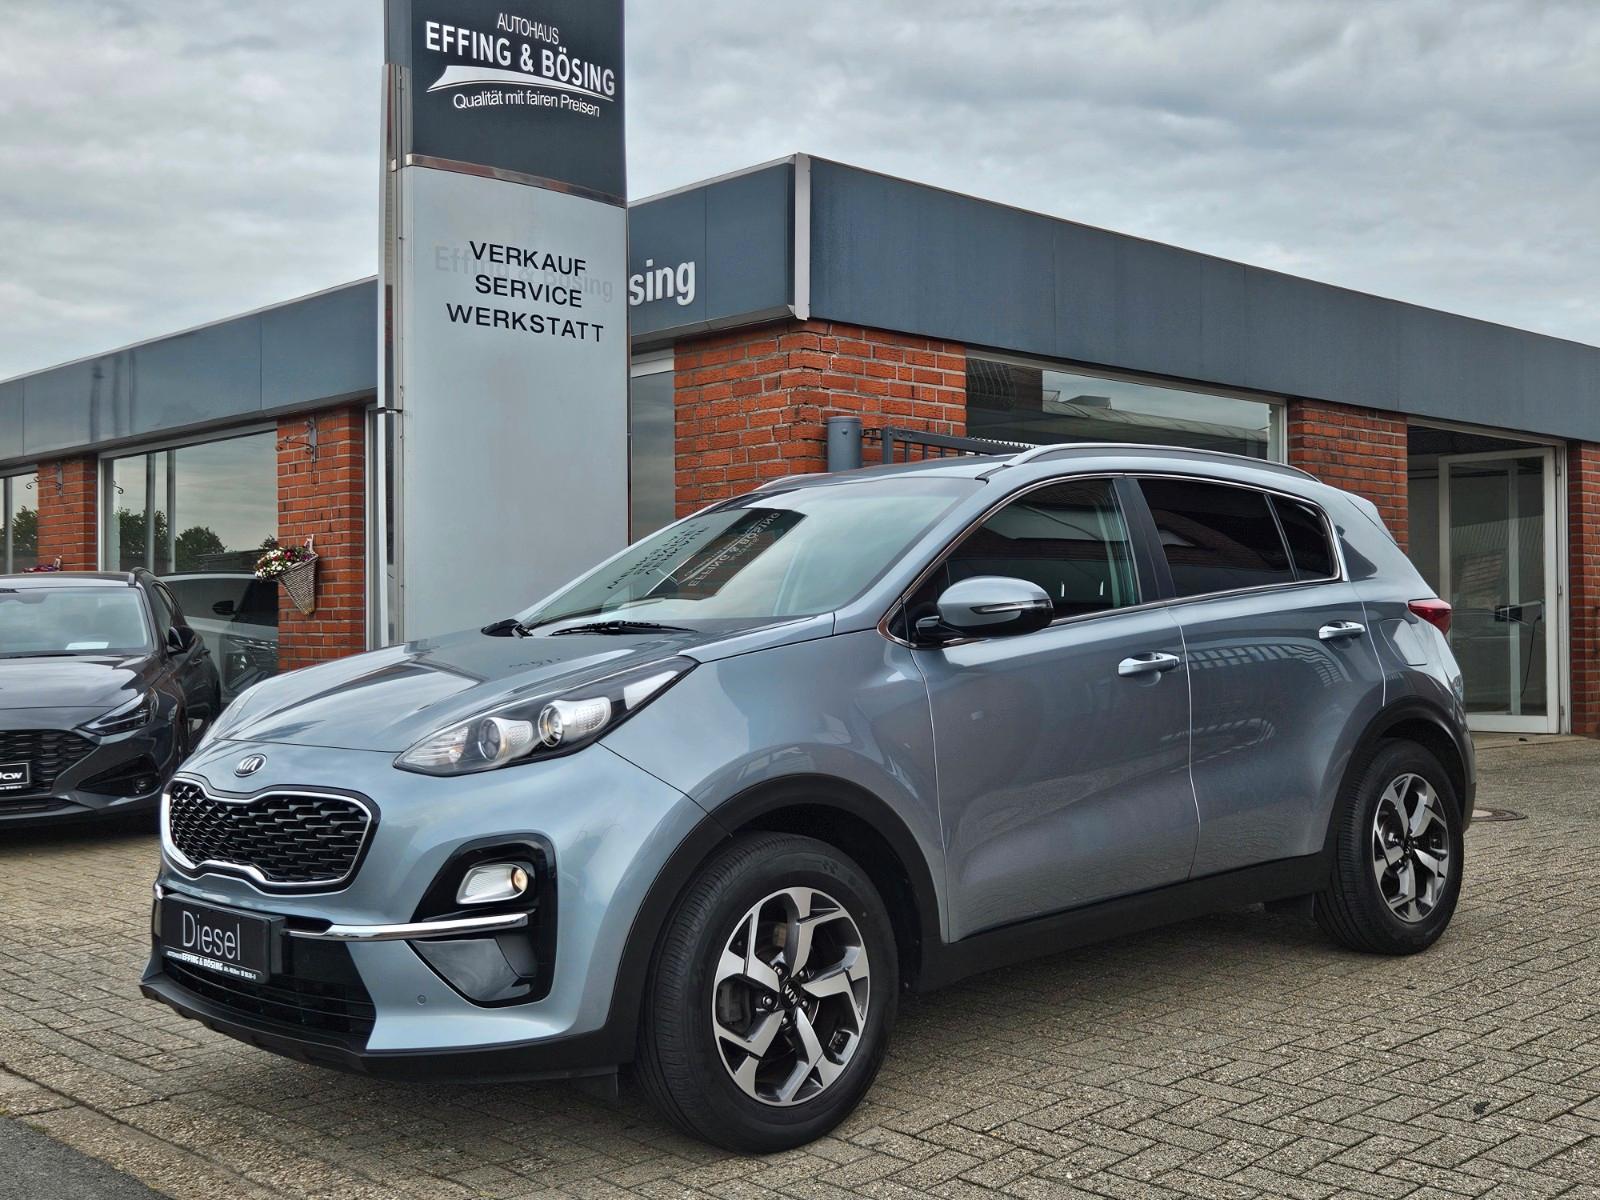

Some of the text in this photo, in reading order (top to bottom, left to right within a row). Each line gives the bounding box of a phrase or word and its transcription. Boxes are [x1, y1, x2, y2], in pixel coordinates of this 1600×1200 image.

[497, 12, 559, 45] AUTOHAUS
[425, 20, 615, 96] EFFING & BÖSING
[453, 90, 600, 117] Qualität mit fairen Preisen
[469, 240, 586, 277] VERKAUF
[475, 274, 582, 308] SERVICE
[446, 303, 604, 343] WERKSTATT
[182, 910, 241, 961] Diesel
[784, 984, 799, 1006] KIA
